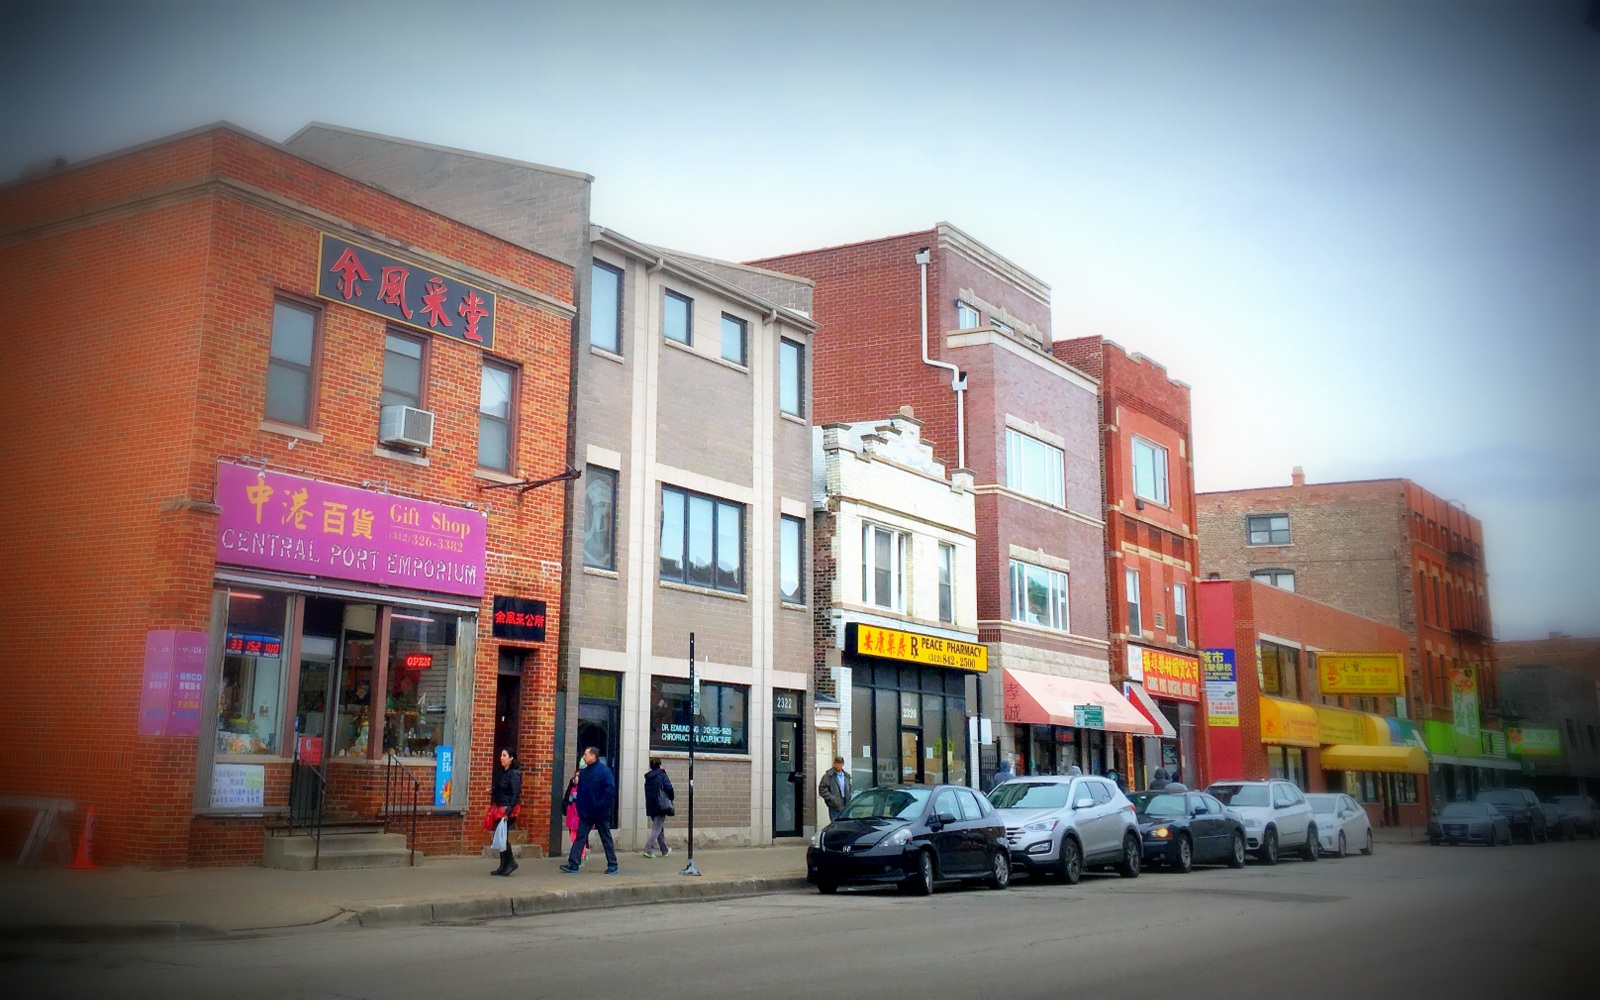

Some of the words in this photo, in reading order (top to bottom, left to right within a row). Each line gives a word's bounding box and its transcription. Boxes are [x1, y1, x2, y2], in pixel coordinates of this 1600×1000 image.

[330, 247, 489, 342] 余風采堂
[246, 477, 374, 540] 中港百貨
[390, 503, 420, 526] Gift
[431, 511, 471, 540] Shop
[221, 528, 321, 563] CENTRAL
[329, 544, 380, 572] PORT
[387, 552, 477, 585] EMPORIUM
[406, 655, 432, 667] OPEN
[921, 637, 943, 652] PEACE
[946, 642, 982, 658] PHARMACY
[777, 696, 792, 709] 2322
[670, 724, 690, 733] EDMUND
